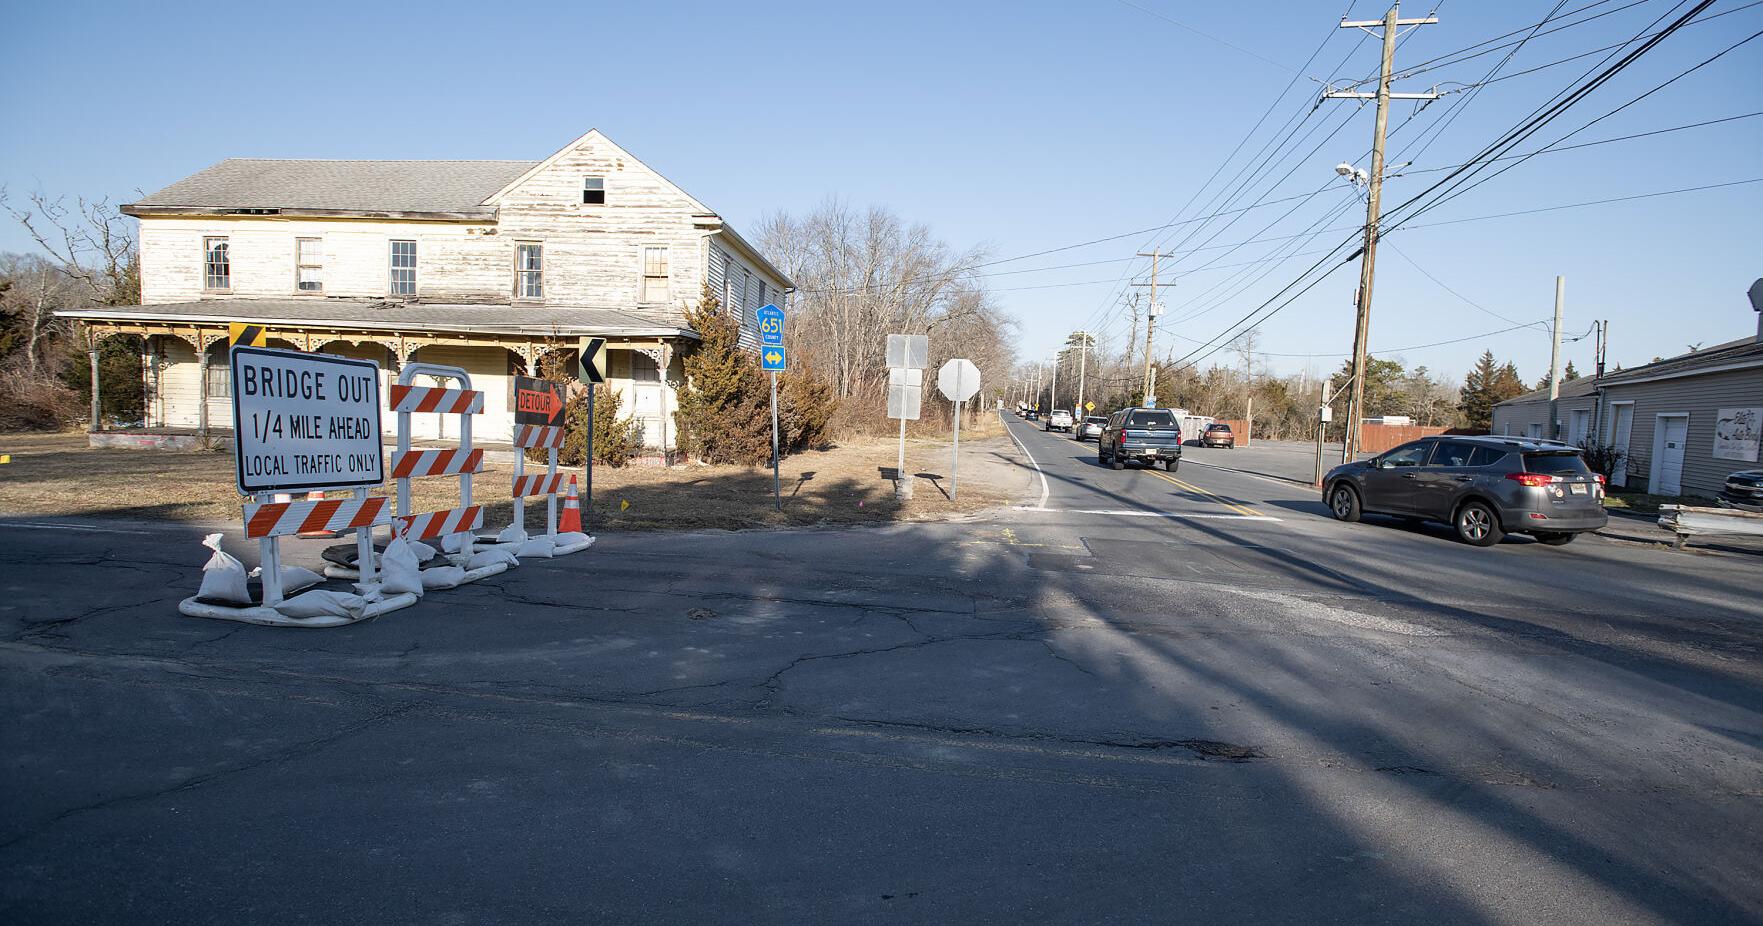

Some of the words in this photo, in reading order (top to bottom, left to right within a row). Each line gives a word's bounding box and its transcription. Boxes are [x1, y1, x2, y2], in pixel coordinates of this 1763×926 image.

[762, 317, 782, 333] 651
[244, 365, 325, 400] BRIDGE
[338, 374, 371, 403] OUT
[520, 391, 551, 411] DETOUR
[253, 410, 282, 443] 1/4
[289, 414, 323, 439] MILE
[329, 416, 370, 440] AHEAD
[246, 455, 288, 476] LOCAL
[294, 454, 342, 474] TRAFFIC
[348, 454, 375, 472] ONLY
